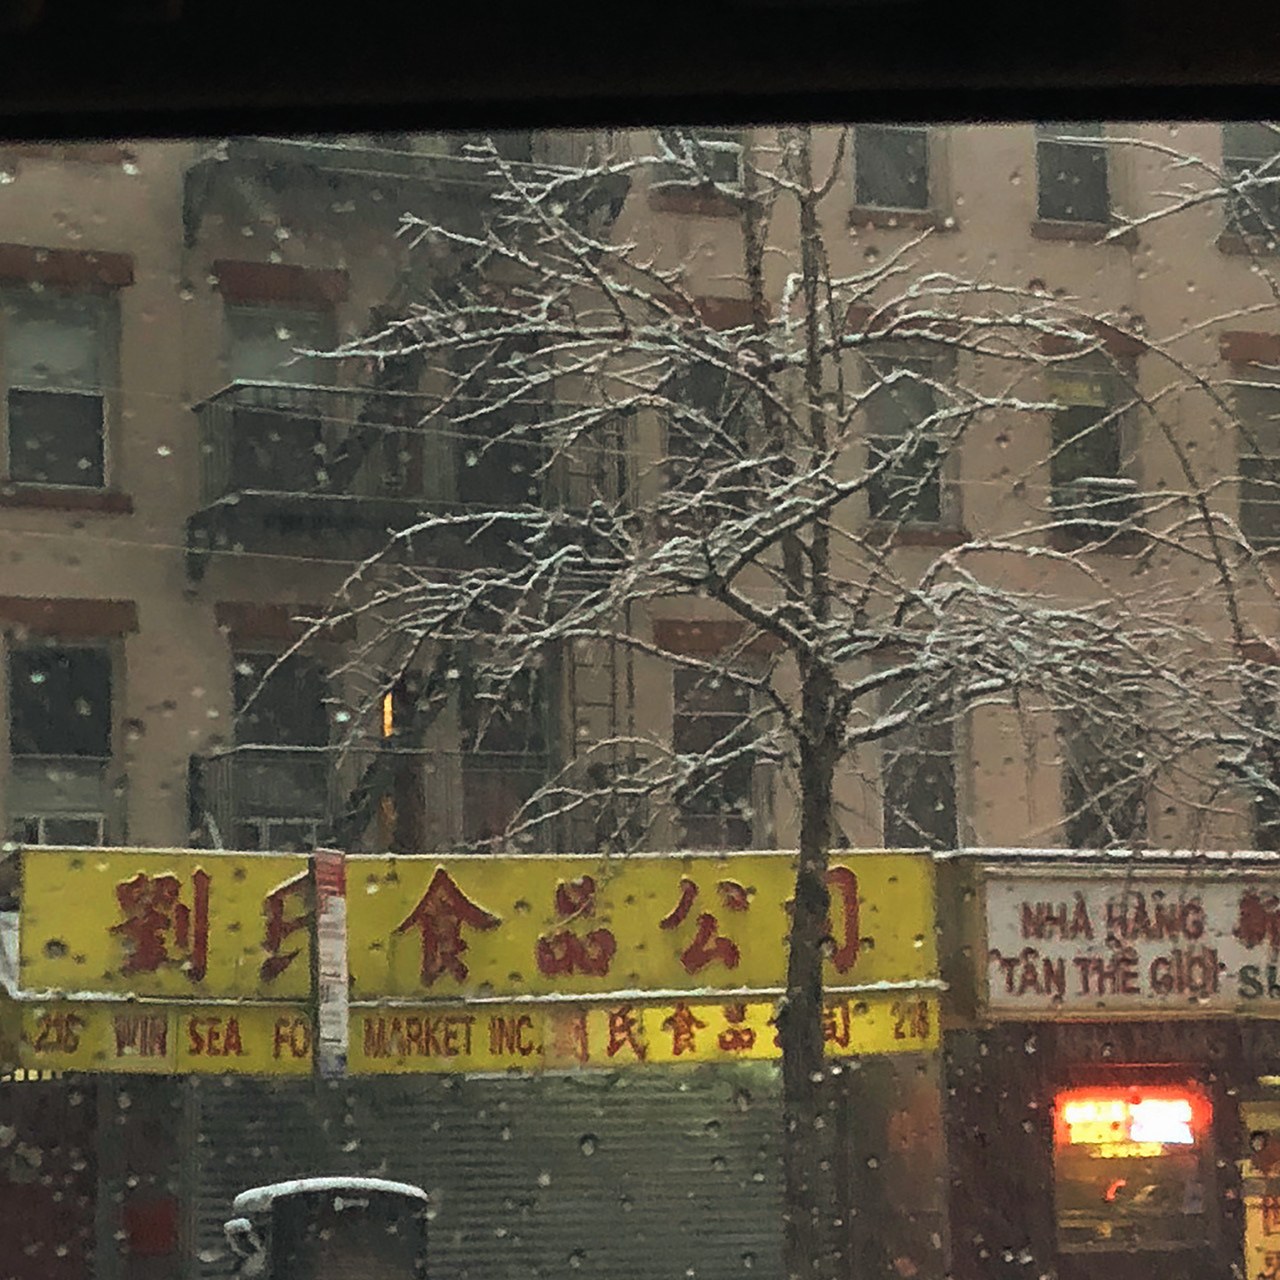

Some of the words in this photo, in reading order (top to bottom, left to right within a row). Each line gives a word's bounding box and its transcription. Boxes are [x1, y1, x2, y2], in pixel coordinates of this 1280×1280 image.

[187, 1016, 243, 1057] SEA
[363, 1016, 475, 1058] MARKET
[489, 1015, 543, 1056] INC.
